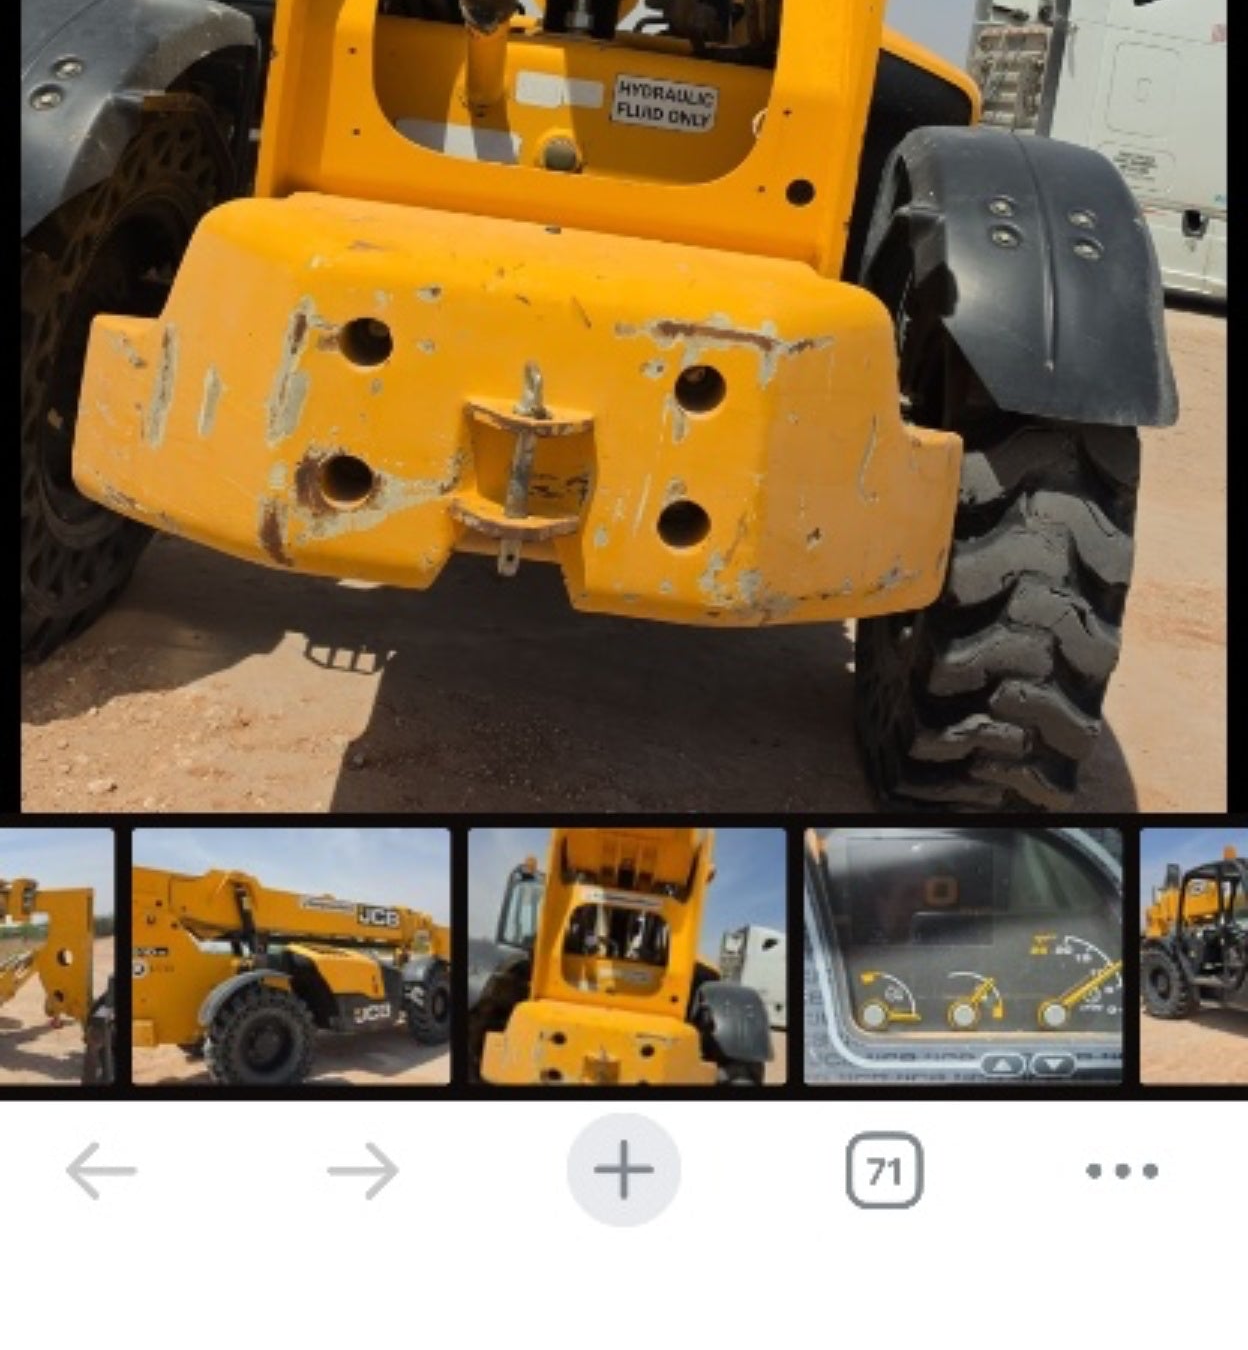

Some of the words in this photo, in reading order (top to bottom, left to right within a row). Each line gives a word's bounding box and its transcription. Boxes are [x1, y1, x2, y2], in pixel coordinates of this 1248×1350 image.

[619, 80, 715, 109] HYDRAULIC
[617, 102, 664, 122] FLUID
[668, 110, 711, 128] ONLY
[359, 905, 401, 927] JCB
[867, 1157, 901, 1186] 71
